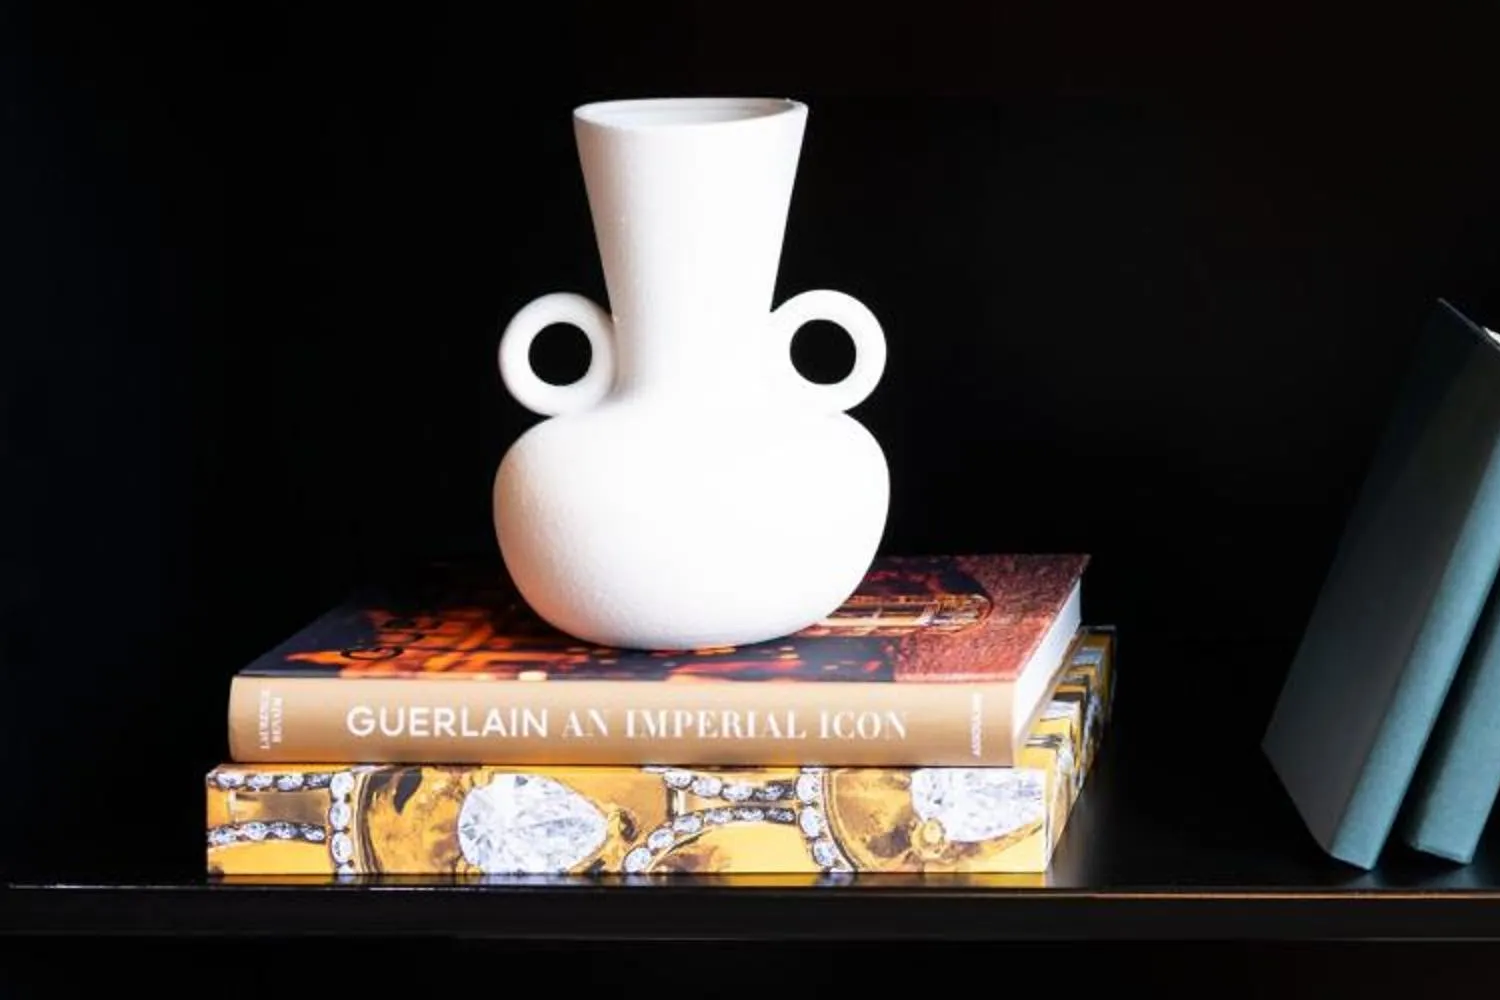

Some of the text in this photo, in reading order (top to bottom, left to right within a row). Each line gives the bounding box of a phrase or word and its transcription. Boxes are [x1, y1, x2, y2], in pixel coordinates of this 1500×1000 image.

[346, 706, 909, 740] GUERLAIN AN IMPERIAL ICON
